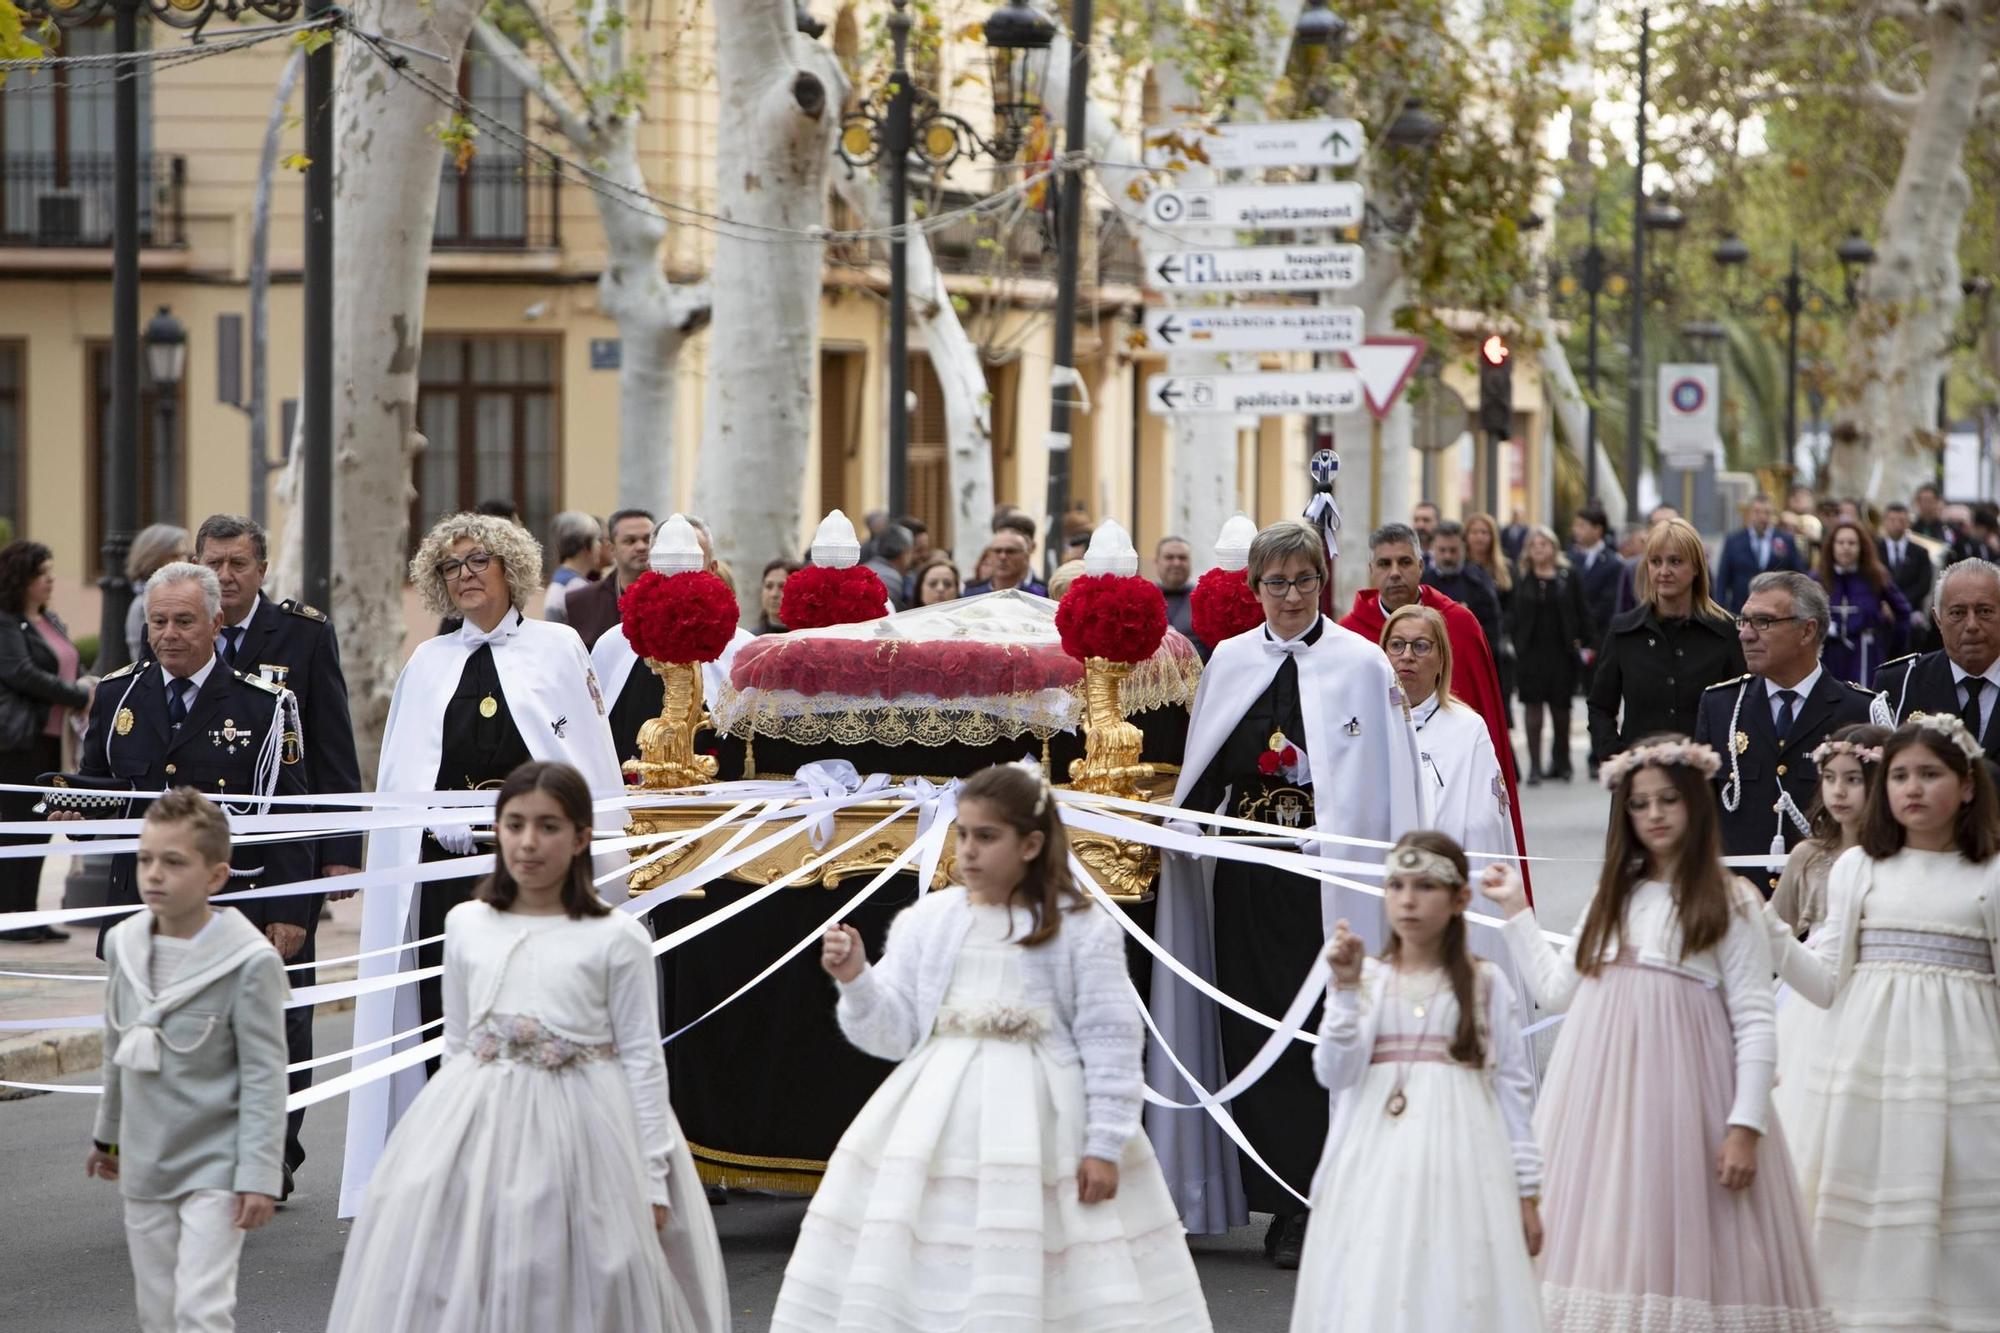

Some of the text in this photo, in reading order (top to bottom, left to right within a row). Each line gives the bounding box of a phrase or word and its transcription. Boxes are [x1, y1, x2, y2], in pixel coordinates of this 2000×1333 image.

[1240, 204, 1351, 224] ajuntament
[1285, 252, 1352, 265] hospital
[1214, 267, 1352, 283] LLUIS ALCANYIS
[1207, 316, 1275, 328] VALENCIA
[1306, 390, 1354, 405] local
